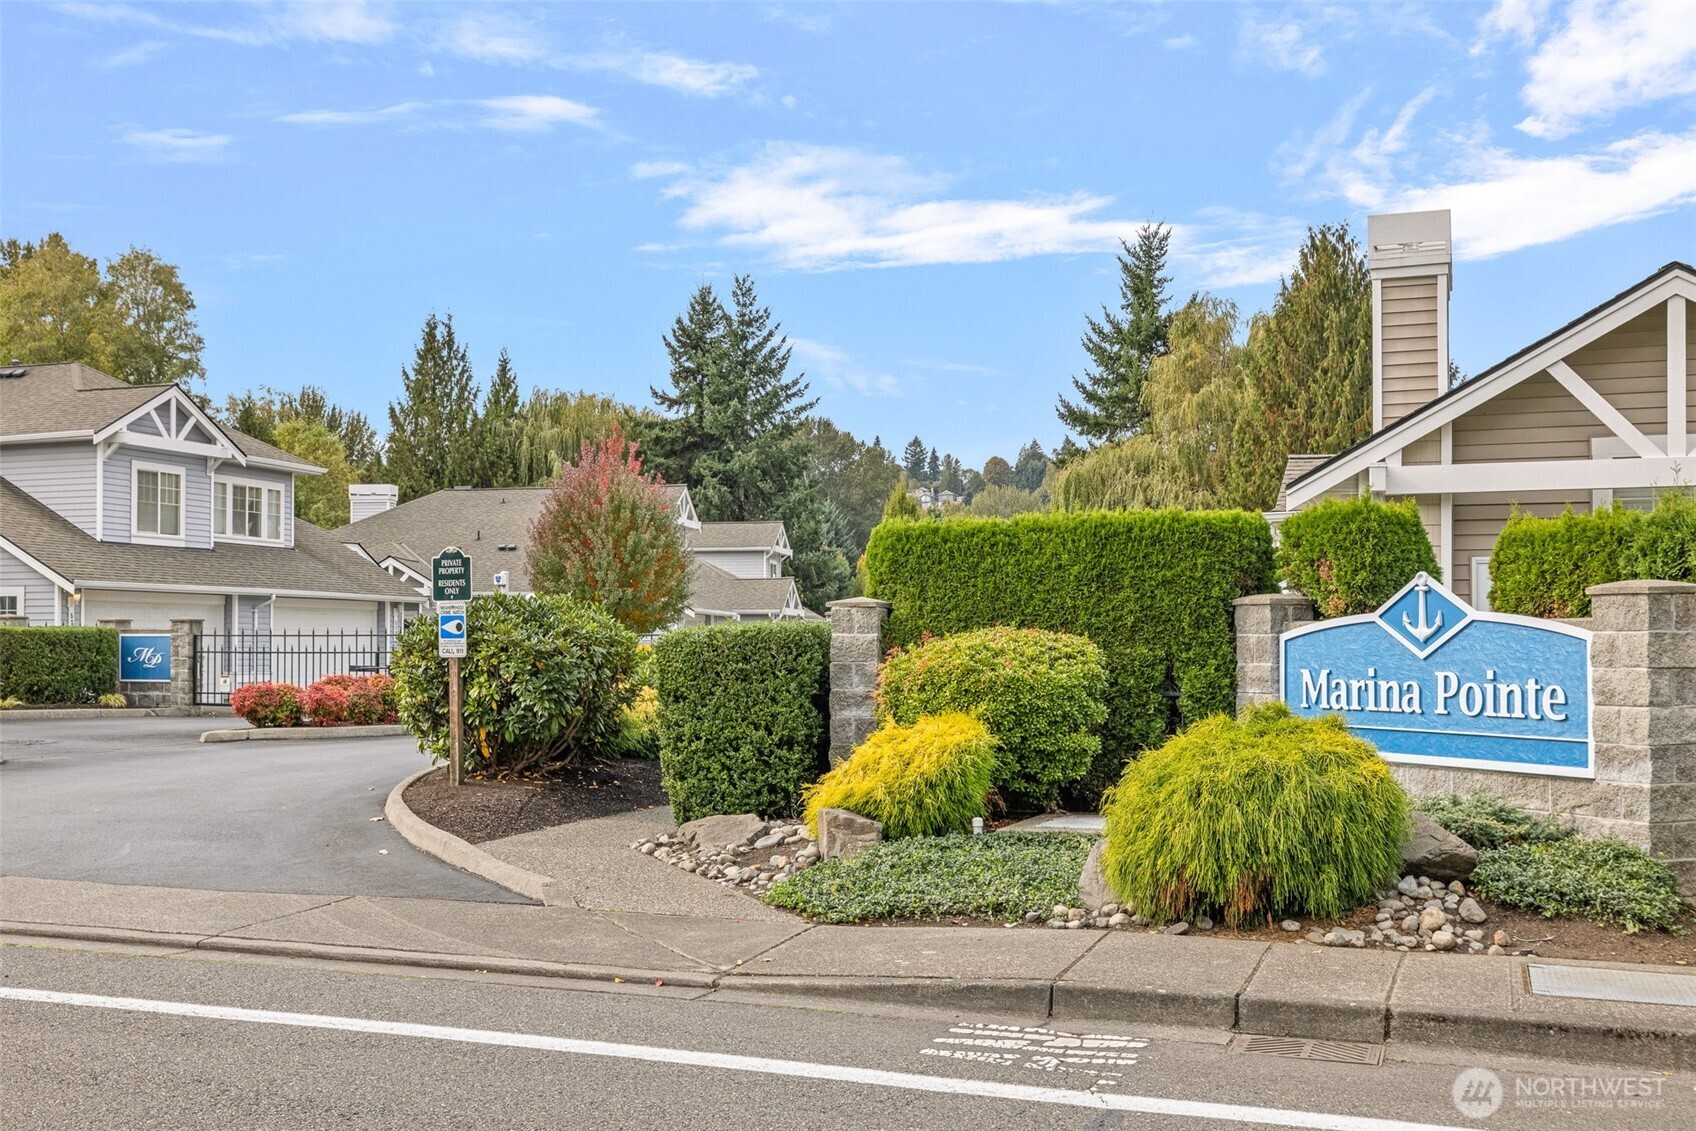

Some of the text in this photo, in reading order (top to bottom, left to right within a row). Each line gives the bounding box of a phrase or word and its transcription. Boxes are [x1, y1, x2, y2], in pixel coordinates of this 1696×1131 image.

[441, 559, 463, 567] PRIVATE
[438, 567, 465, 575] PROPERTY
[438, 579, 466, 587] RESIDENTS
[444, 587, 460, 595] ONLY
[1300, 667, 1568, 722] Marina Pointe
